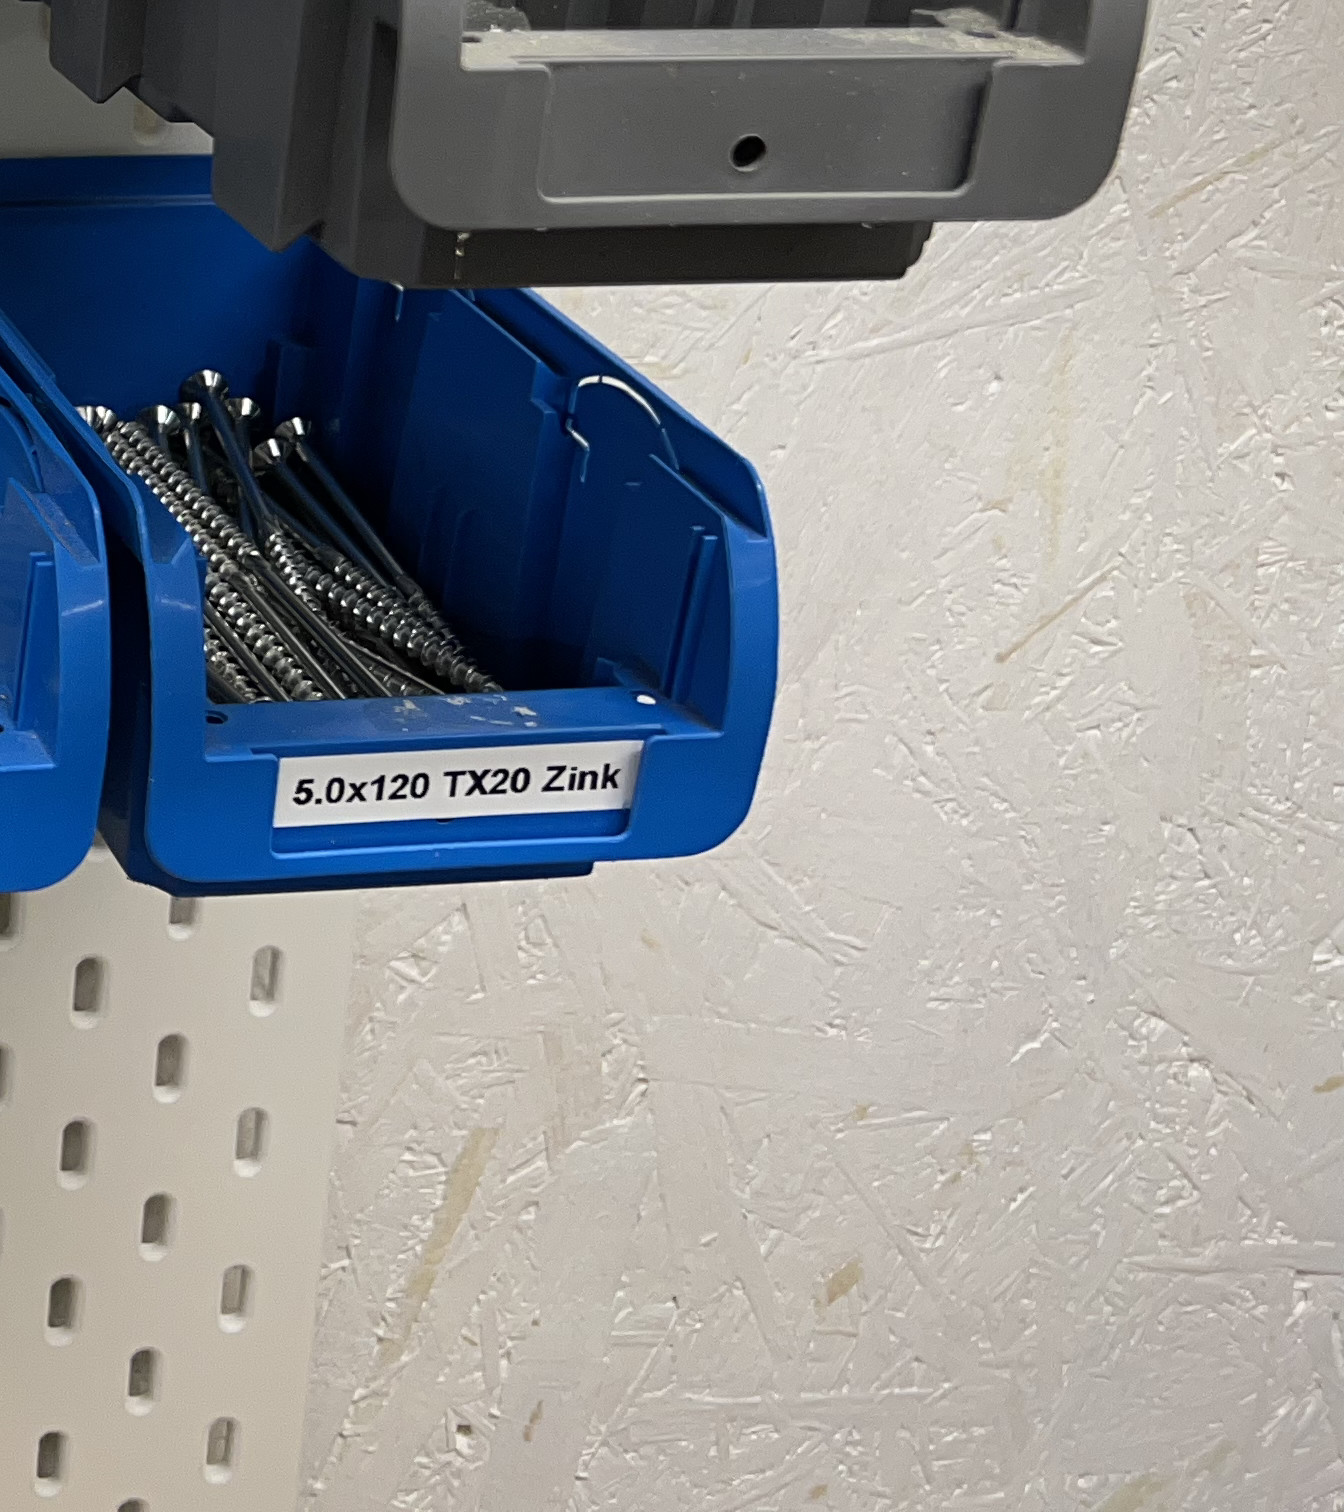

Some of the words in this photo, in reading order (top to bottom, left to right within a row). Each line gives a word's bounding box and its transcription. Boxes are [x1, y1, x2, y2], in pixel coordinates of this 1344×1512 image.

[292, 772, 430, 806] 5.0x120
[443, 767, 531, 798] TX20
[541, 763, 622, 793] Zink
